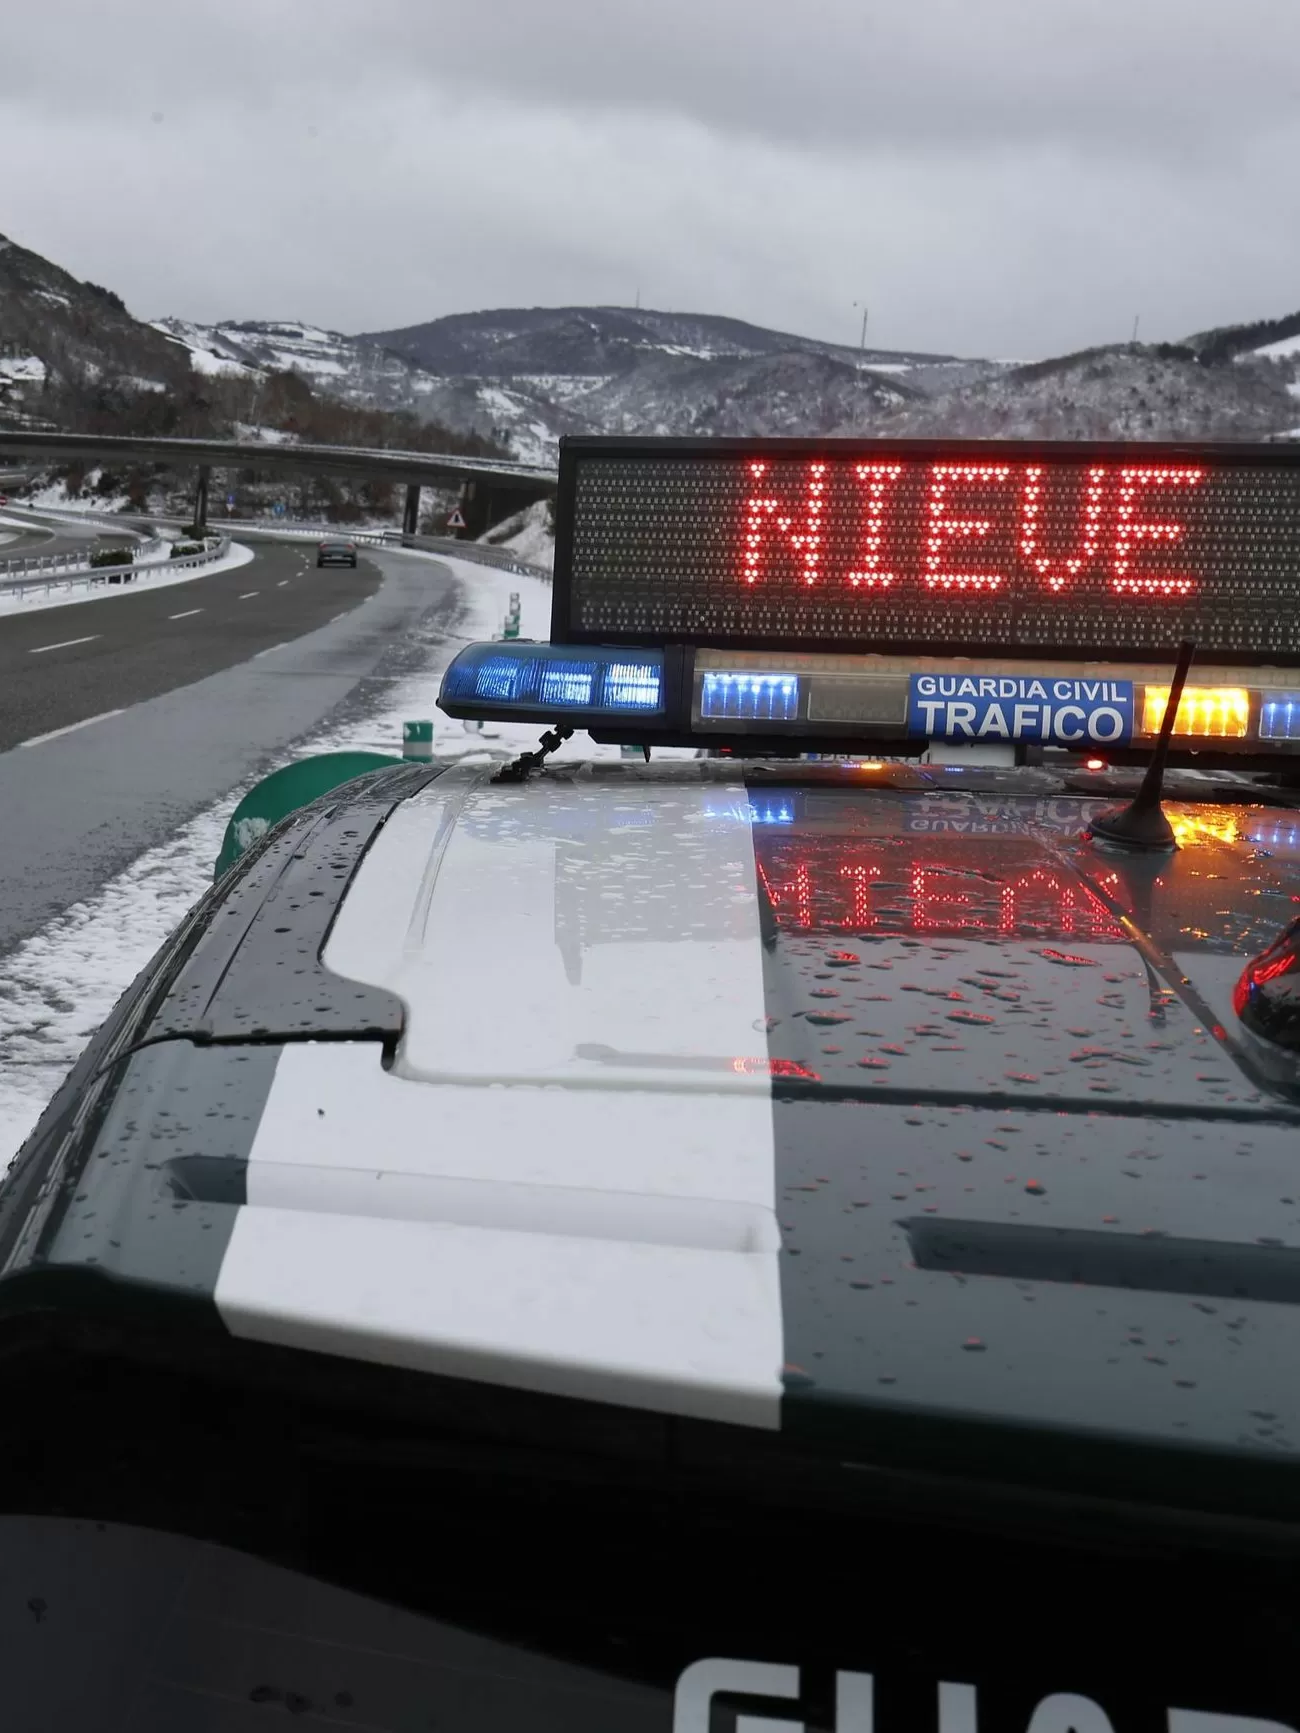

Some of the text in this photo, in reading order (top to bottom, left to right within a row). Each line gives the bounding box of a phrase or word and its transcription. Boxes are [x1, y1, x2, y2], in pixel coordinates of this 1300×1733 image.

[744, 463, 1202, 594] NIEVE
[917, 676, 1127, 702] GUARDIA CIVIL
[917, 700, 1124, 742] TRAFICO
